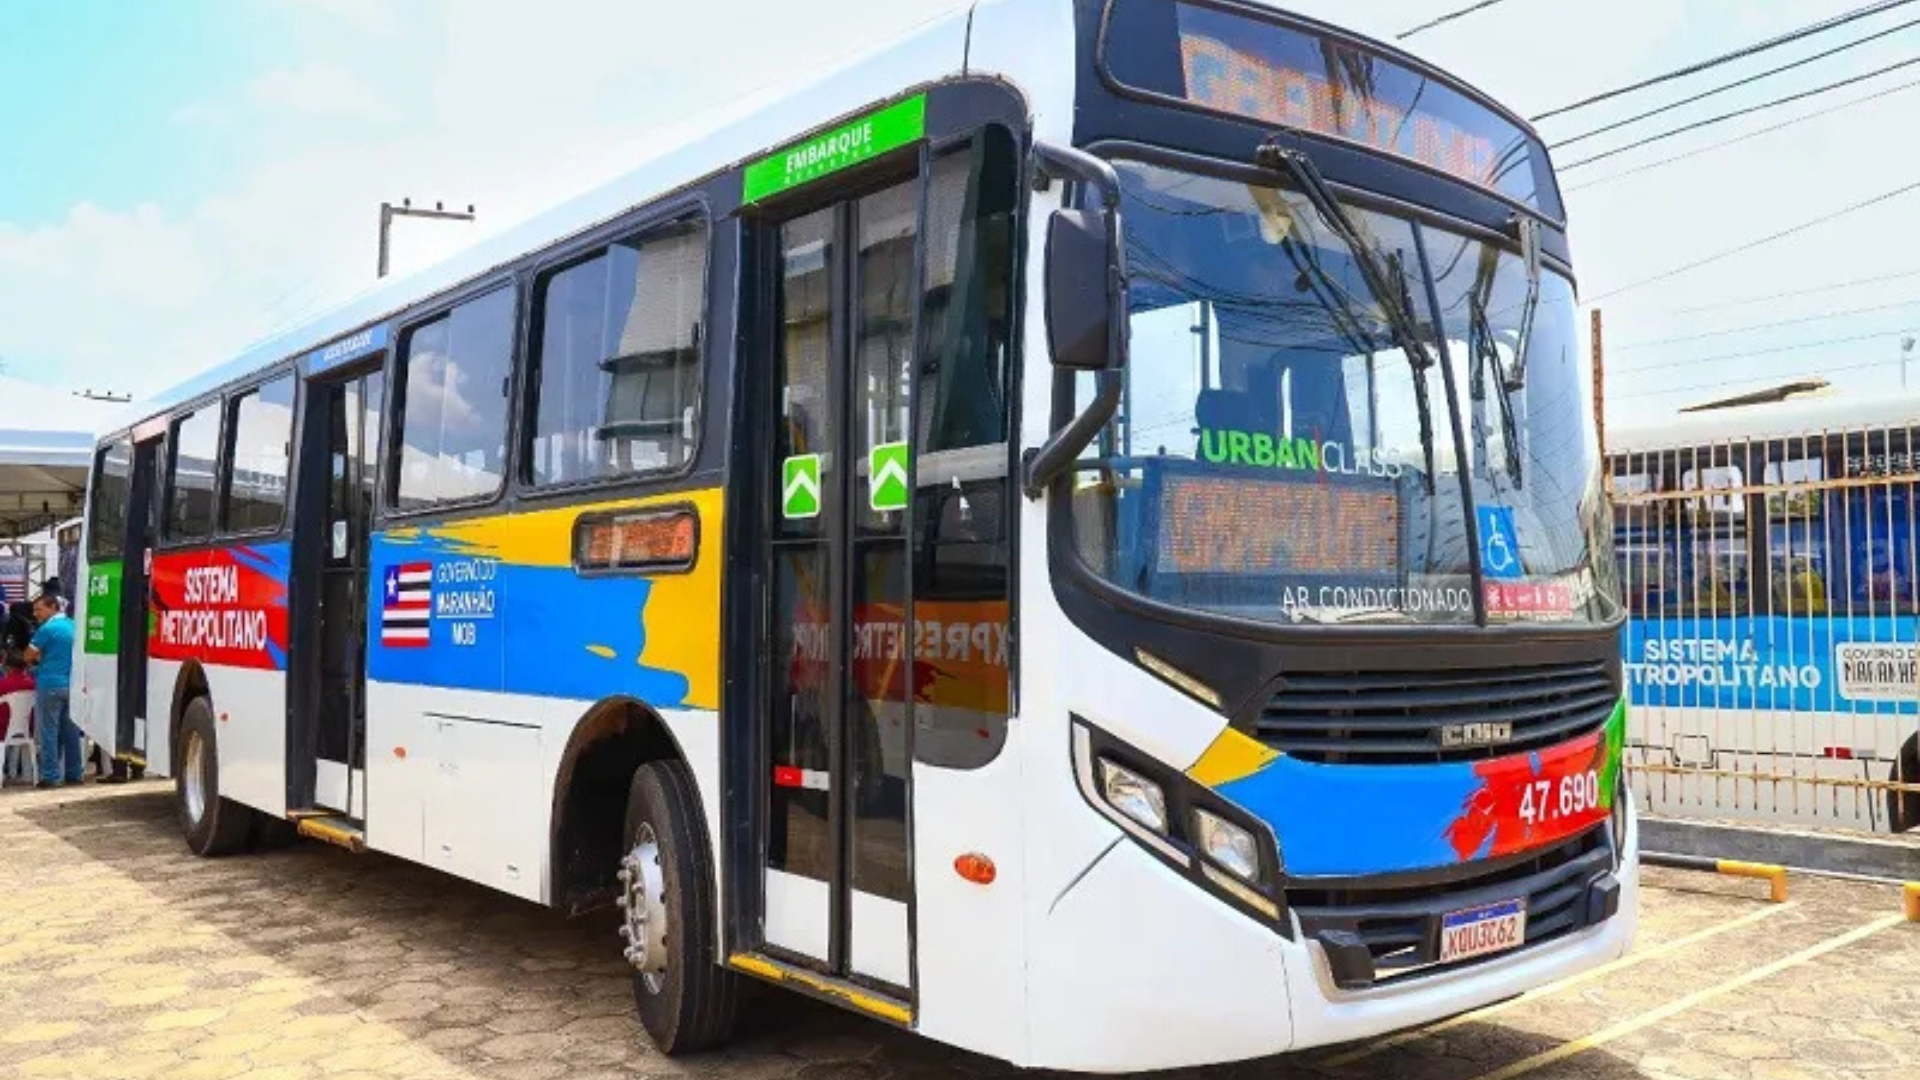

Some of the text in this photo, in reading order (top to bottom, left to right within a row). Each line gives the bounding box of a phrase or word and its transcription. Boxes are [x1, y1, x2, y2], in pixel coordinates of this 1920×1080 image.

[786, 122, 873, 174] EMBARQUE
[1201, 428, 1402, 479] URBAN CLASS
[184, 565, 239, 603] SISTEMA
[437, 558, 480, 583] GOVERNO
[436, 584, 496, 614] MARANHÃO
[1281, 585, 1474, 613] AR CONDICIONADO
[161, 609, 267, 651] METROPOLITANO
[452, 621, 477, 646] MOB
[1645, 638, 1759, 663] SISTEMA
[1518, 768, 1599, 825] 47.690
